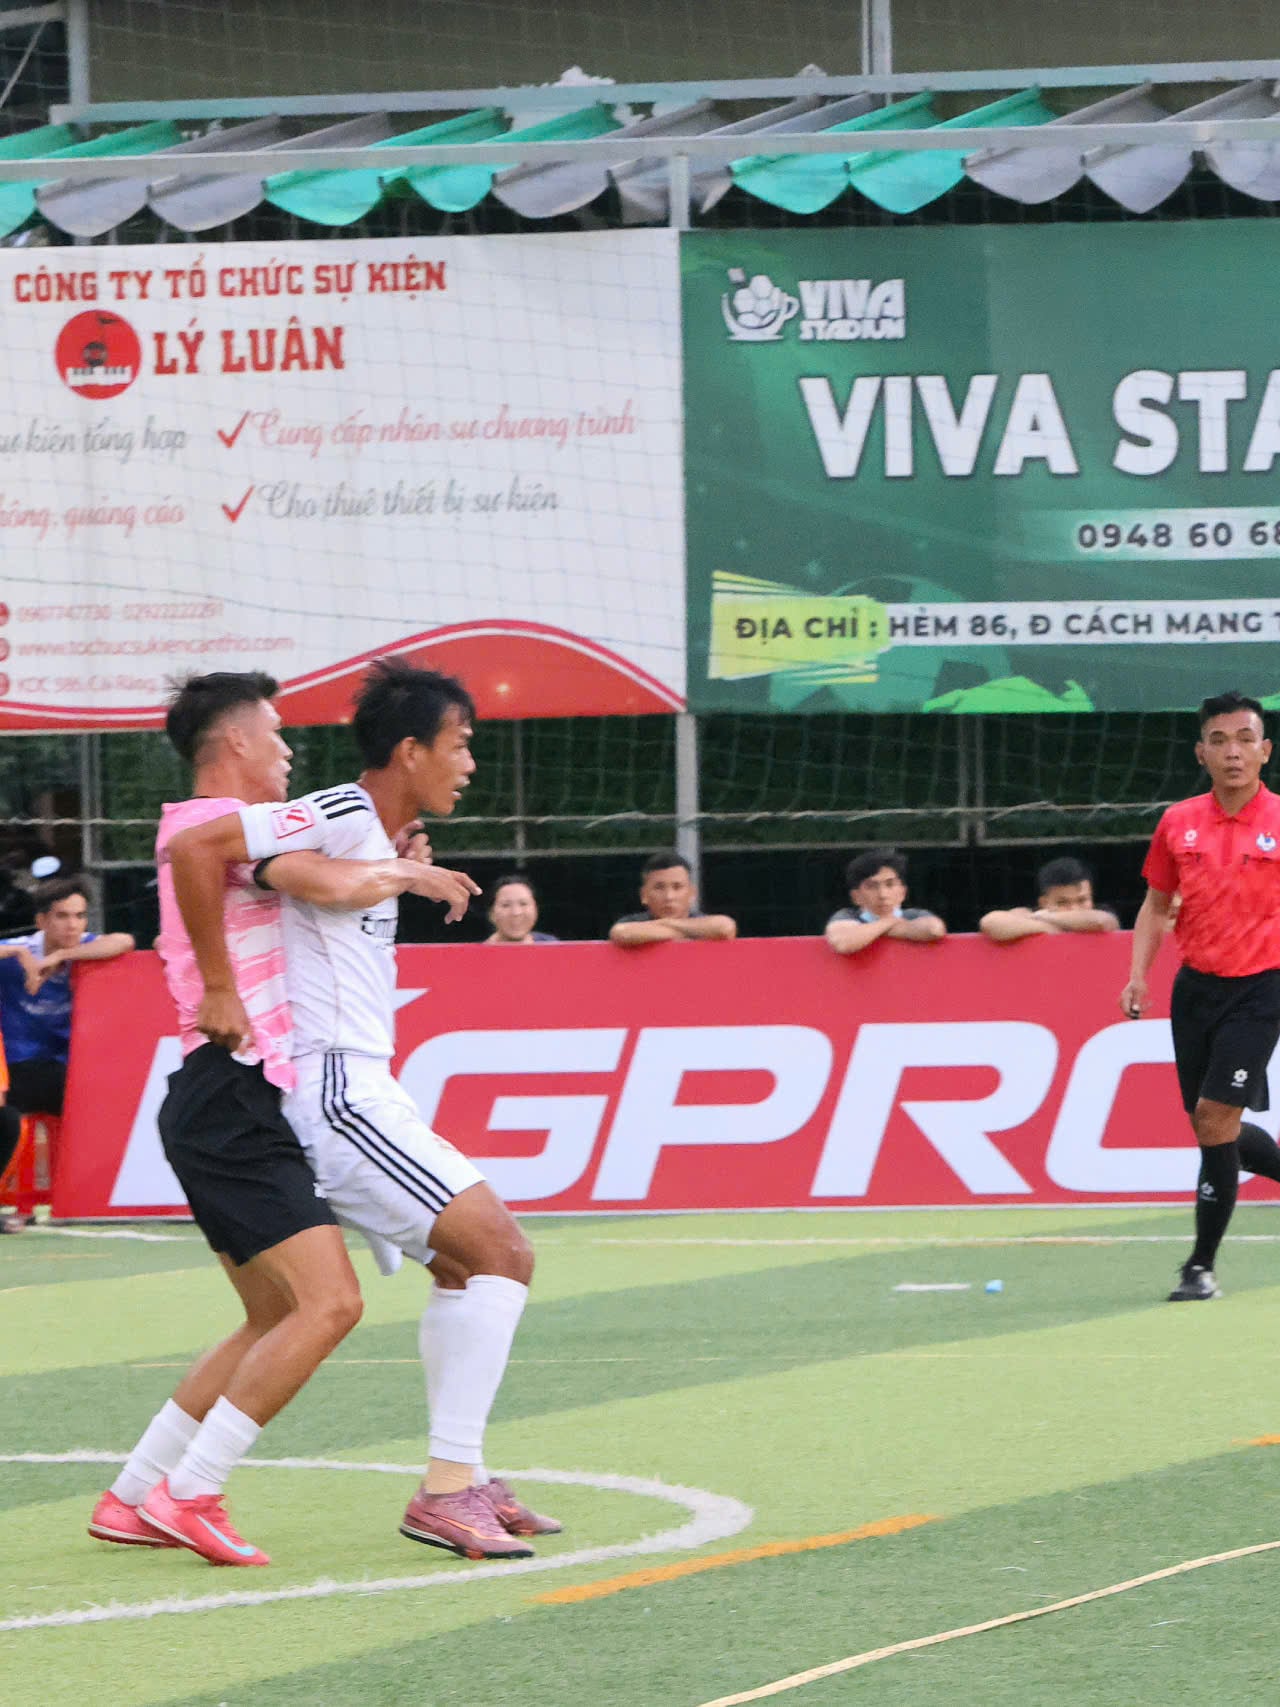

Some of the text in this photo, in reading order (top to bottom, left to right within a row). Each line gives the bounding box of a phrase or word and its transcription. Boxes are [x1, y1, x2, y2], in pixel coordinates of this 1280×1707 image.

[14, 254, 447, 303] CÔNG TY TỔ CHỨC SỰ KIỆN
[798, 278, 905, 320] VIVA
[153, 316, 345, 376] LÝ LUÂN
[799, 317, 906, 341] STADIUM
[249, 407, 323, 459] Cung
[799, 373, 1081, 478] VIVA
[256, 480, 317, 519] Cho
[1078, 522, 1173, 549] 0948
[1189, 522, 1234, 548] 60
[736, 616, 793, 645] ĐỊA
[804, 606, 859, 638] CHỈ
[969, 615, 1018, 641] 86,
[1029, 616, 1052, 635] Đ
[1064, 604, 1154, 636] CÁCH
[1166, 611, 1263, 641] MẠNG
